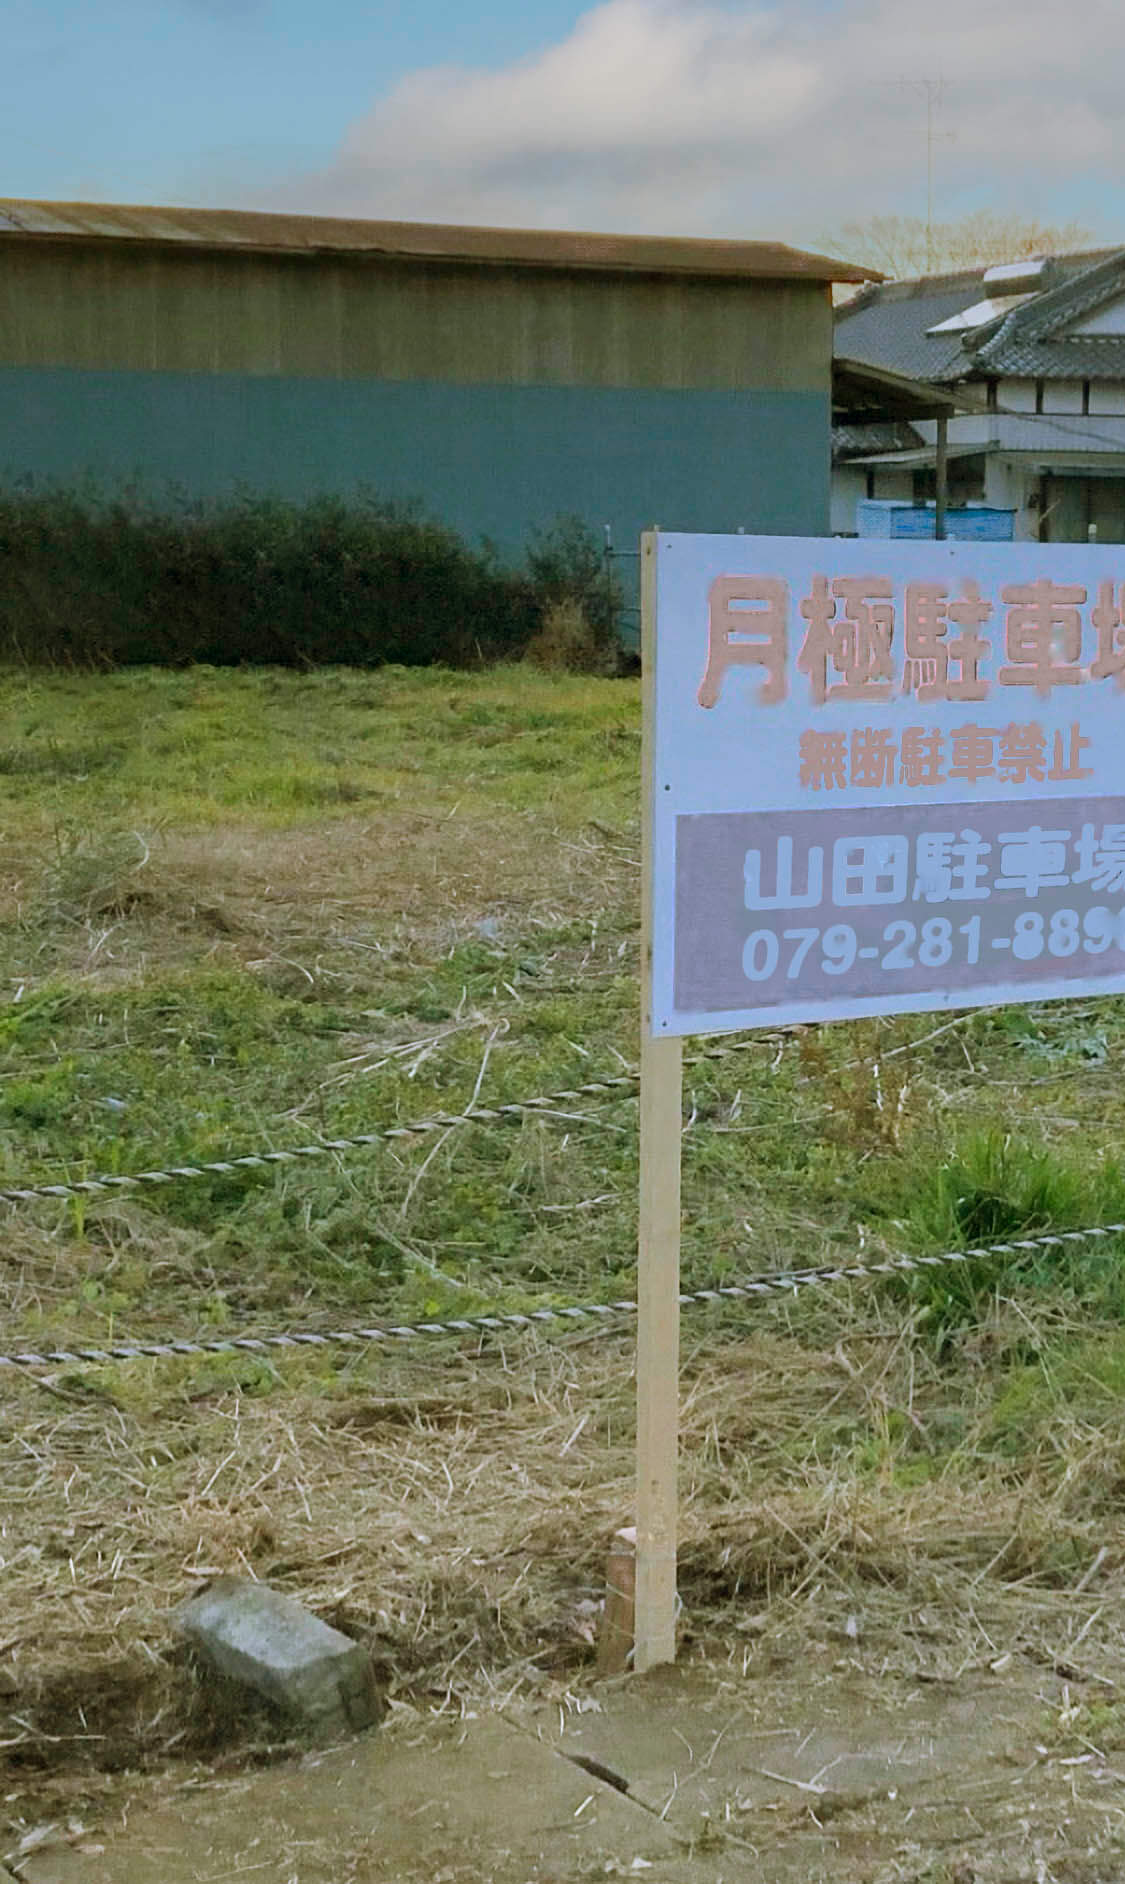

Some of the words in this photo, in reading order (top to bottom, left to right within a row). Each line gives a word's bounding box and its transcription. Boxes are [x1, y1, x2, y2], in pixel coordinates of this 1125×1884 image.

[798, 721, 1094, 791] 無断駐車禁止
